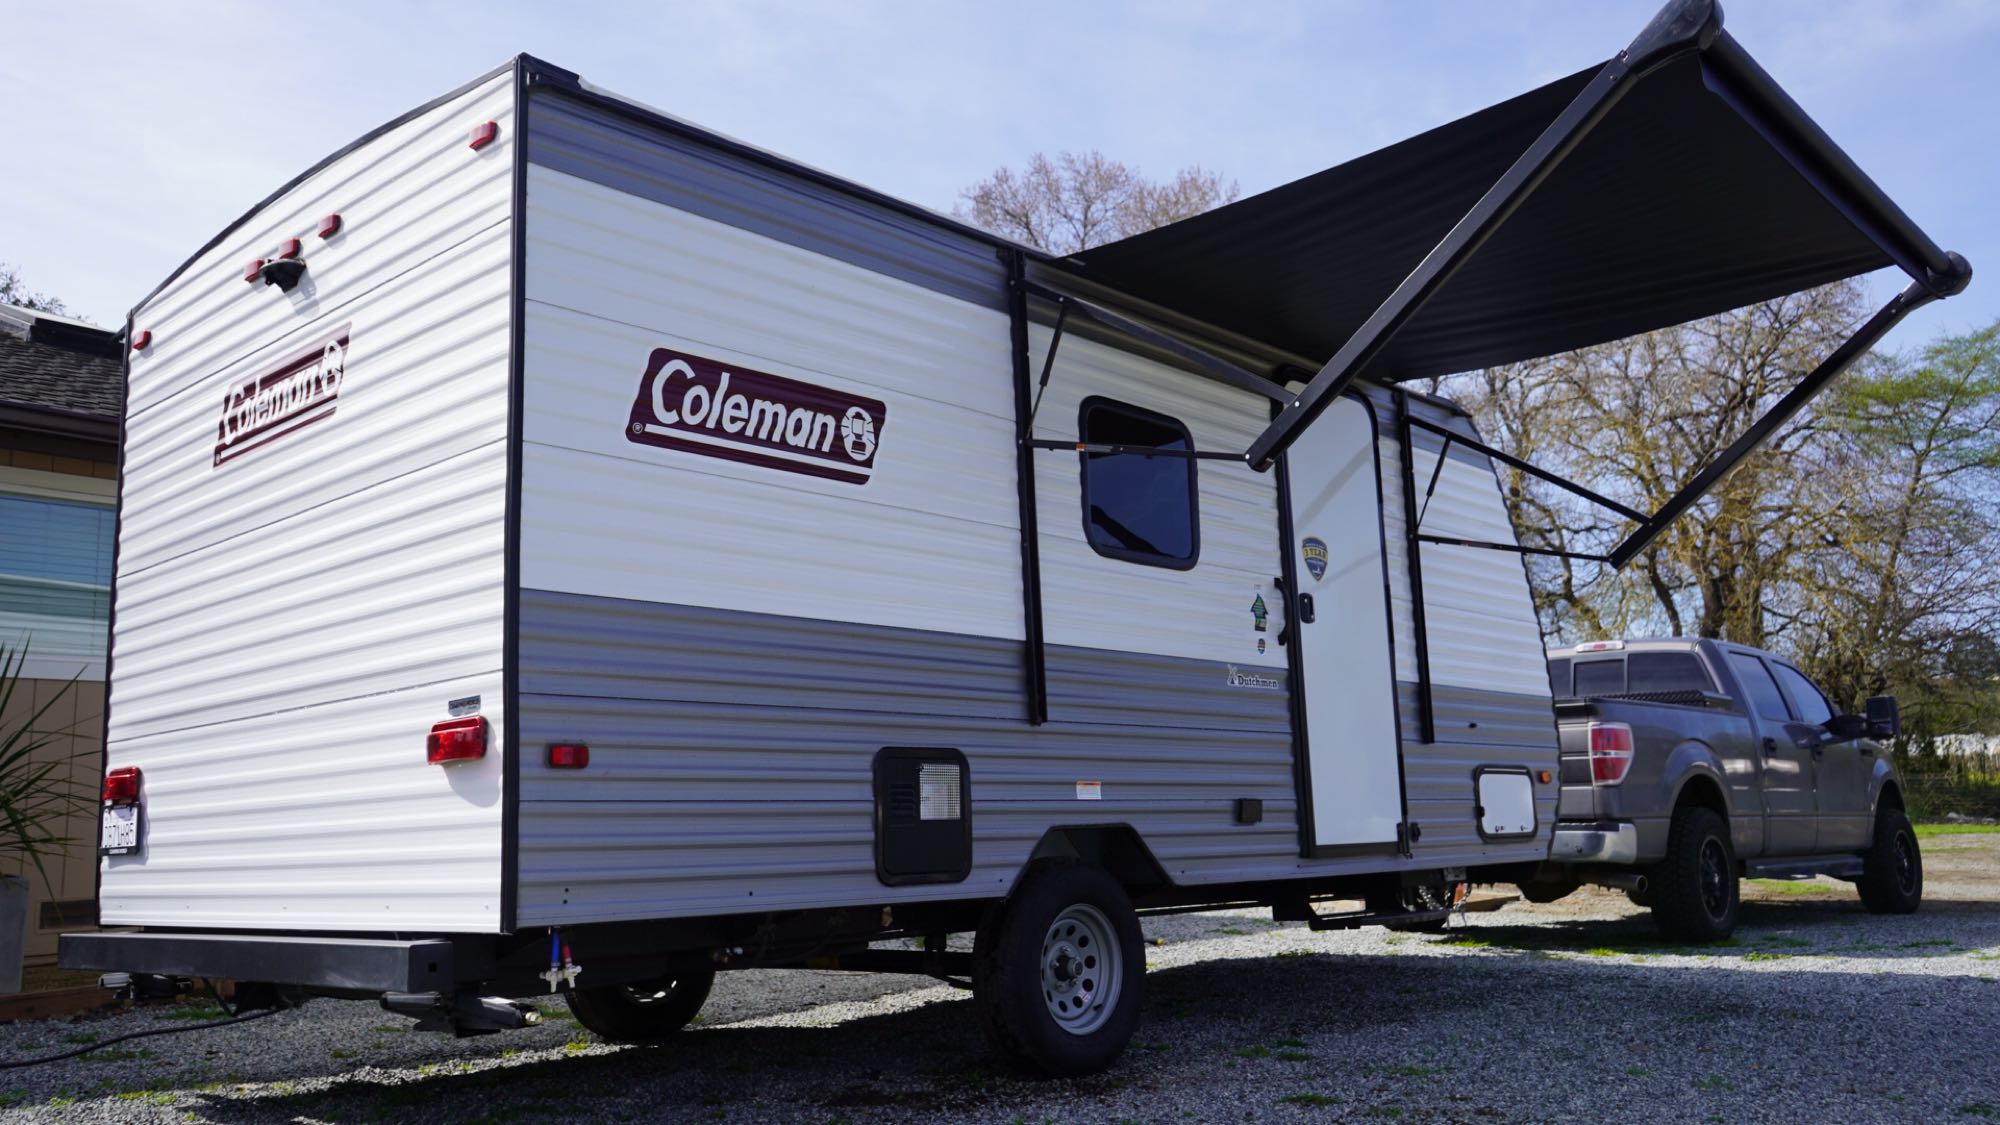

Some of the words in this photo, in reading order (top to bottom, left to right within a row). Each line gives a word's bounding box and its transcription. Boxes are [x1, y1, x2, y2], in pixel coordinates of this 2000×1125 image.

[223, 365, 320, 446] Coleman
[652, 359, 836, 453] Coleman
[1237, 674, 1278, 689] Dutchmen
